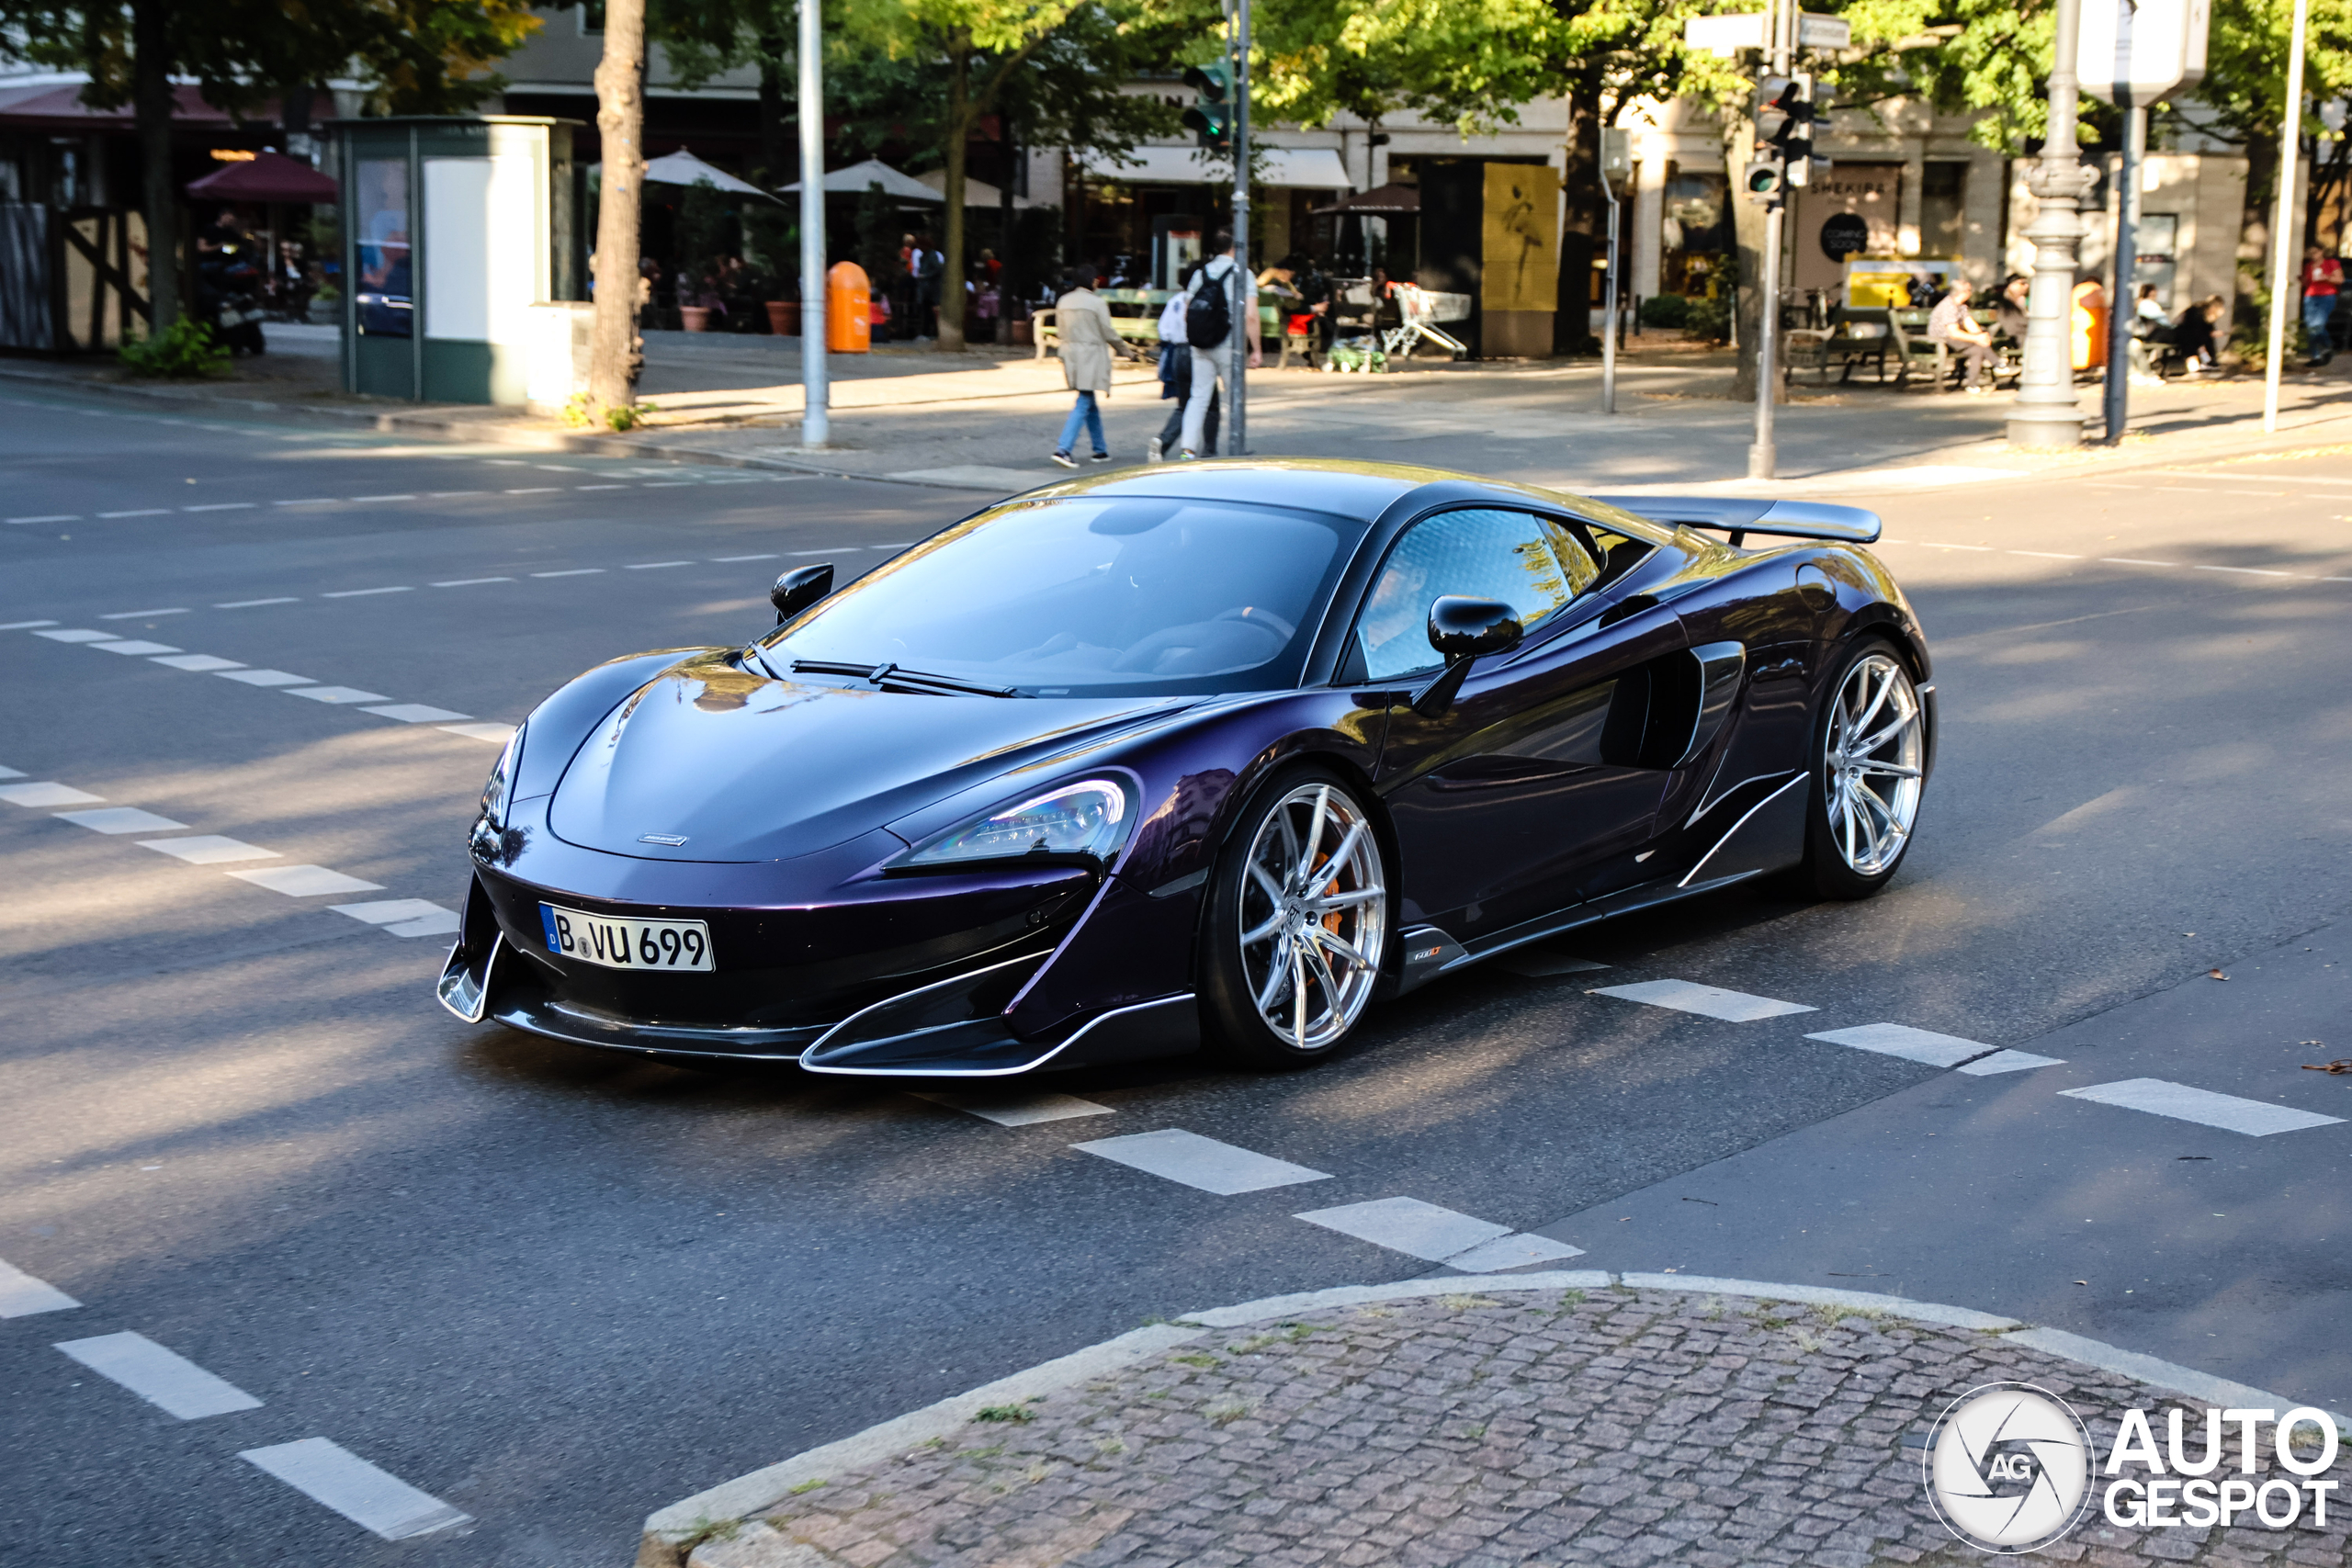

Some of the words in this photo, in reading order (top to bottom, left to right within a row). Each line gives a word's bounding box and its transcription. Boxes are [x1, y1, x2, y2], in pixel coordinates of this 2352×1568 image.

[1826, 229, 1866, 239] COMING
[1830, 239, 1860, 249] SOON
[550, 933, 557, 944] D
[556, 915, 575, 952] B
[589, 922, 631, 964] VU
[639, 928, 705, 965] 699
